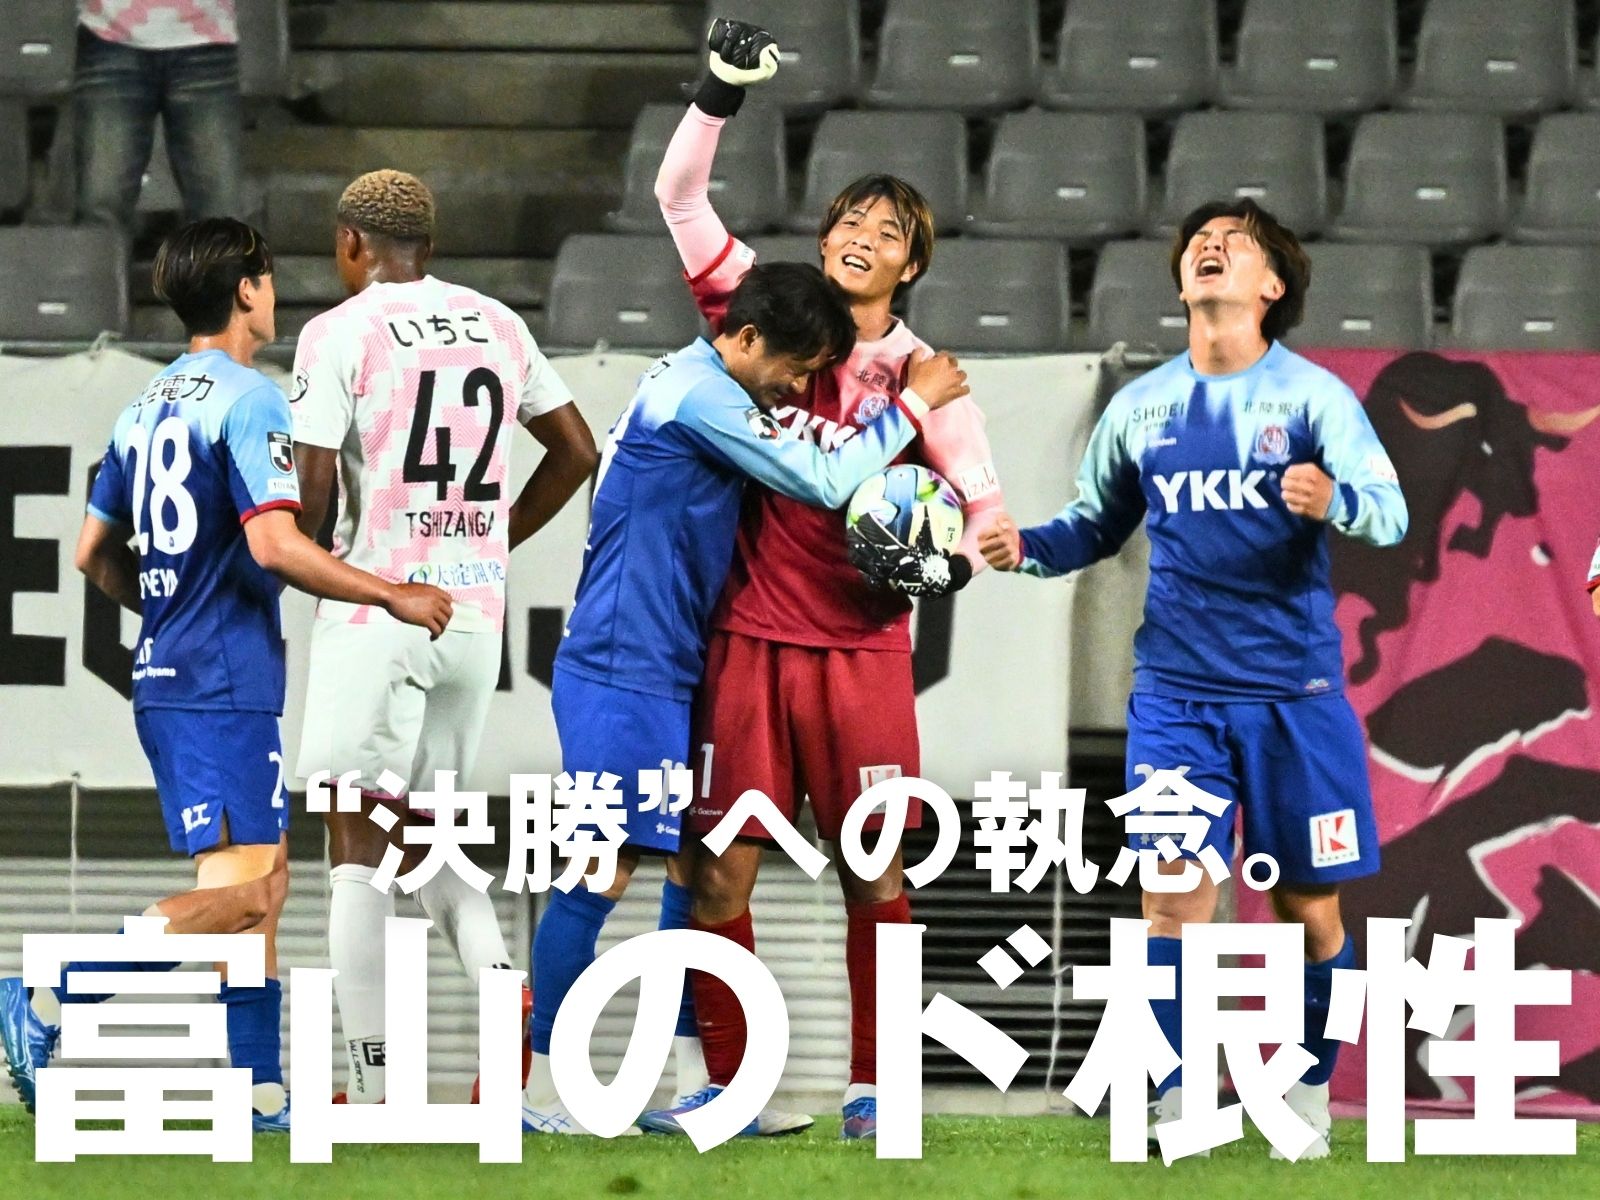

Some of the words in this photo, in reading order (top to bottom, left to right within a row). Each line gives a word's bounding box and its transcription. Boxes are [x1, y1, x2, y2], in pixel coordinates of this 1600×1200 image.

[388, 311, 489, 348] いちご
[402, 366, 504, 501] 42
[1132, 402, 1185, 422] SHOEI
[122, 416, 199, 556] 28
[1152, 468, 1269, 514] YKK
[700, 743, 714, 798] 1
